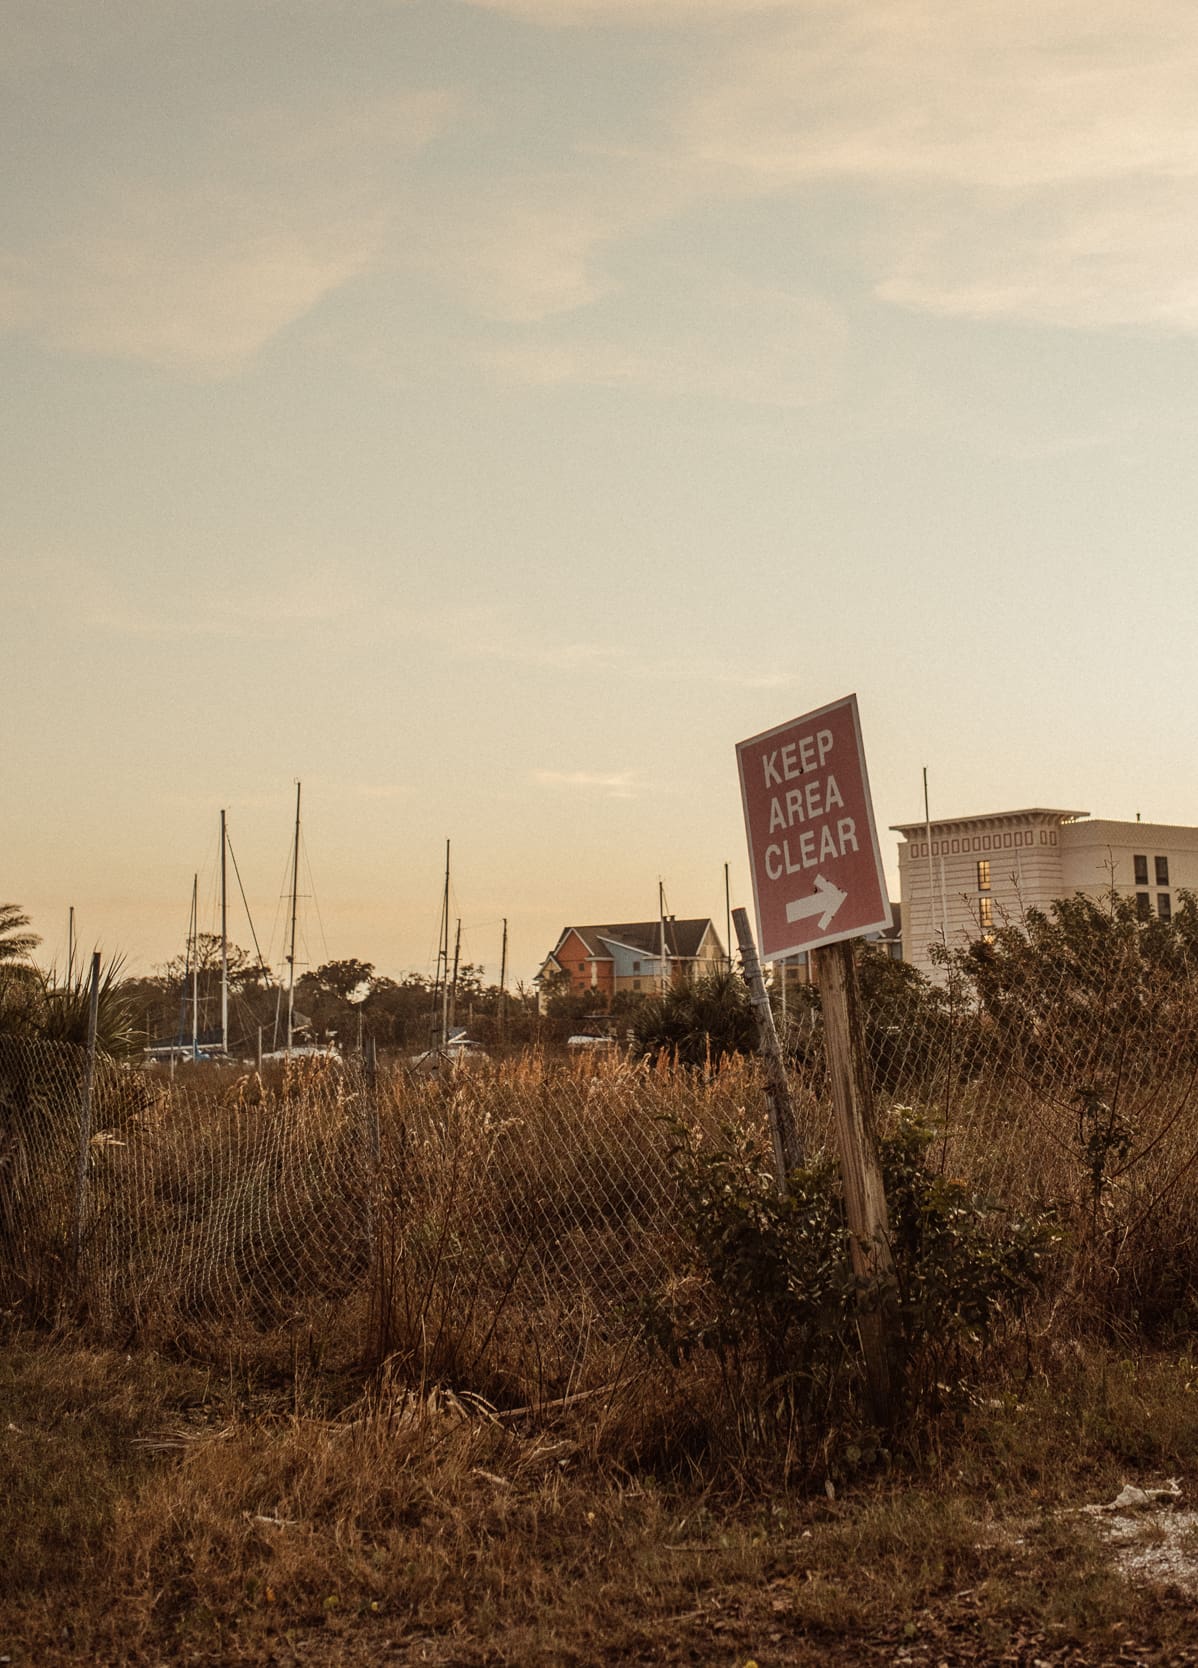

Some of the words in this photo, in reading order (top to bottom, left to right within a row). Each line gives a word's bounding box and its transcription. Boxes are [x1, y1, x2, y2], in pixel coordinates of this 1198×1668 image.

[762, 729, 834, 789] KEEP
[769, 774, 844, 834] AREA
[764, 816, 859, 880] CLEAR
